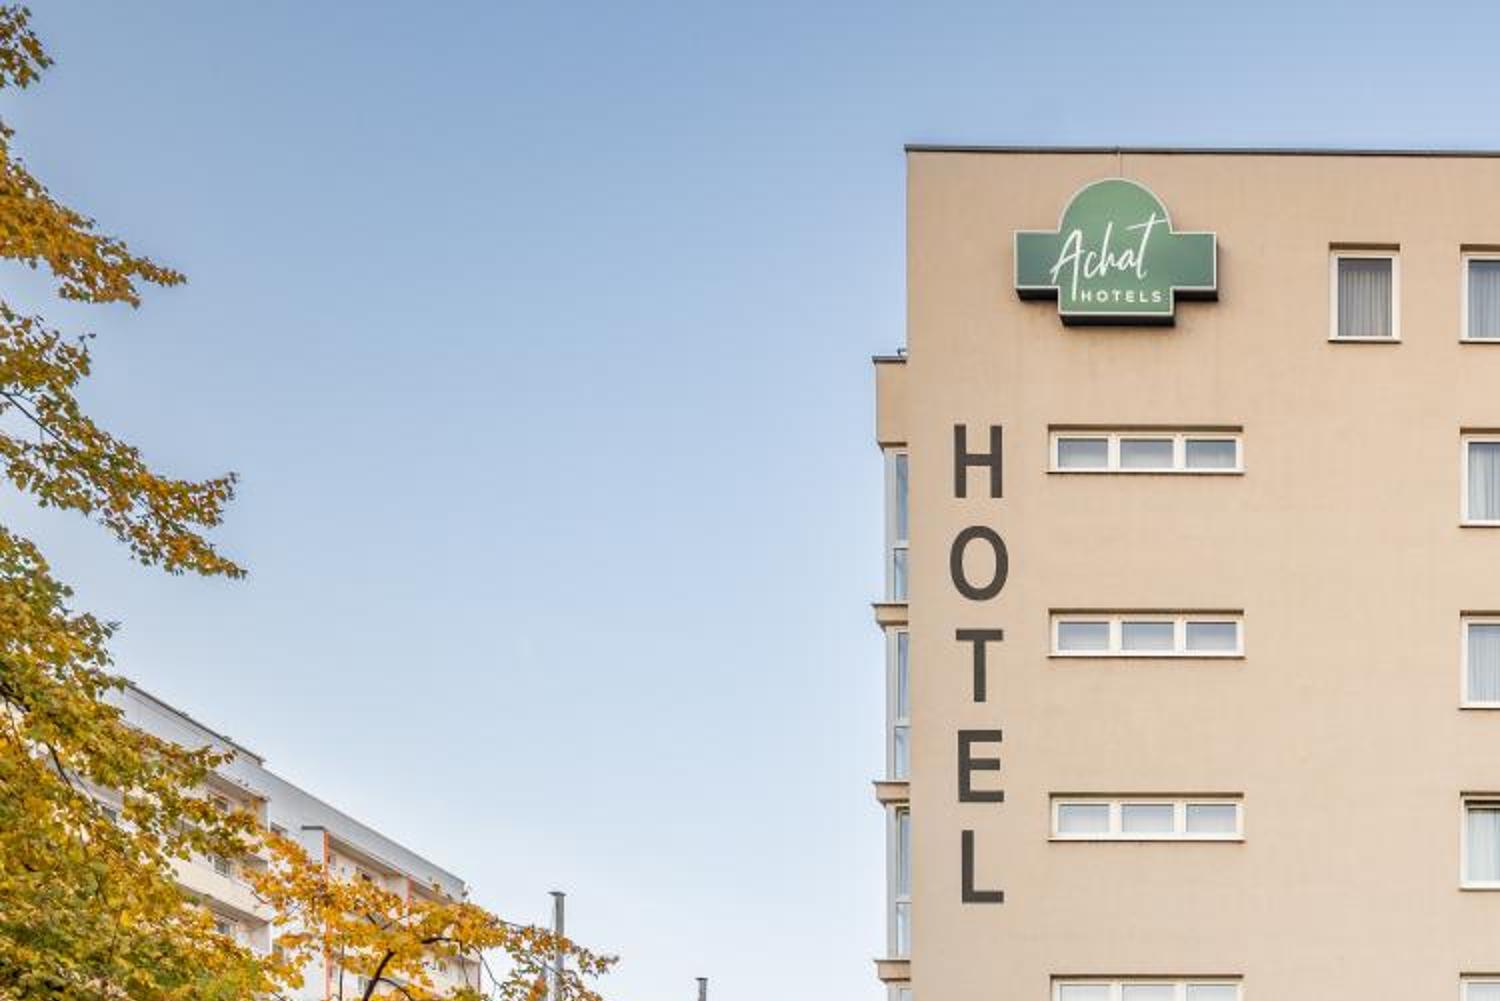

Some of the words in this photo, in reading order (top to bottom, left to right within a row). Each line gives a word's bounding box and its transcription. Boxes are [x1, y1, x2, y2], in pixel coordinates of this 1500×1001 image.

[1050, 211, 1168, 302] Achat
[1080, 289, 1163, 304] HOTELS
[949, 423, 1009, 905] HOTEL
